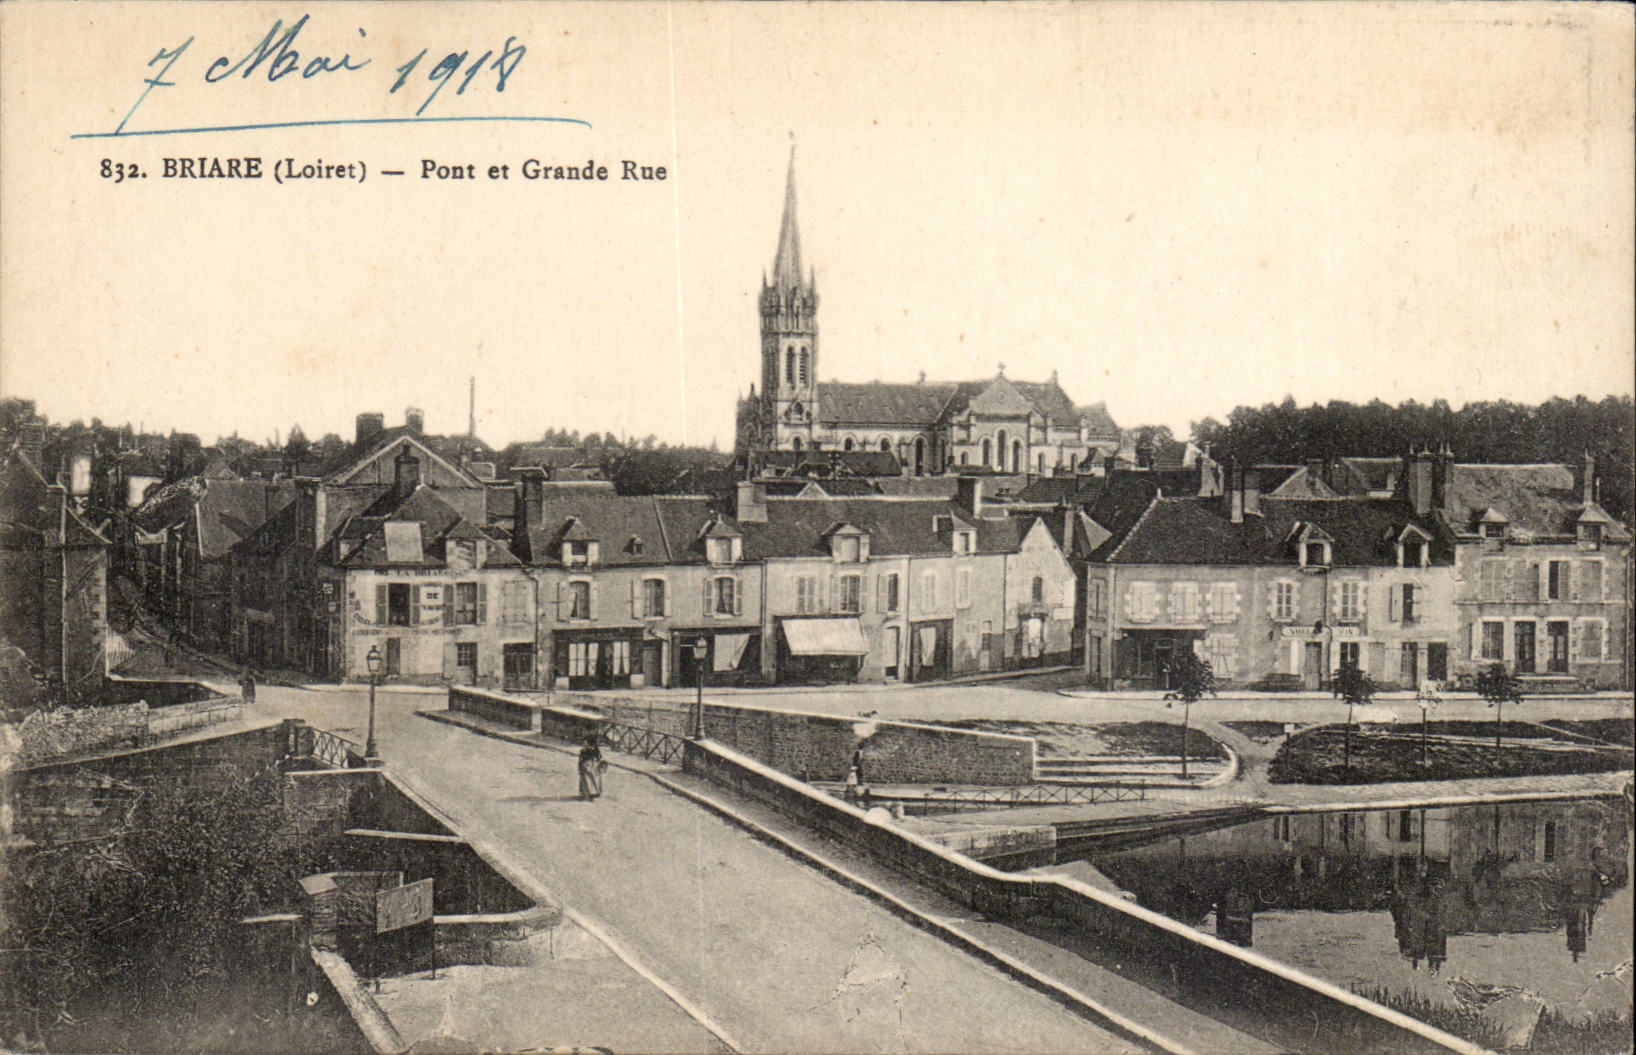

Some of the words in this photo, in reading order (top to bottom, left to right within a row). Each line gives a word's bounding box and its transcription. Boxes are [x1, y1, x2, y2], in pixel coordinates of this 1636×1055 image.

[115, 36, 194, 135] 7
[205, 14, 371, 83] Mai
[389, 36, 527, 117] 1918
